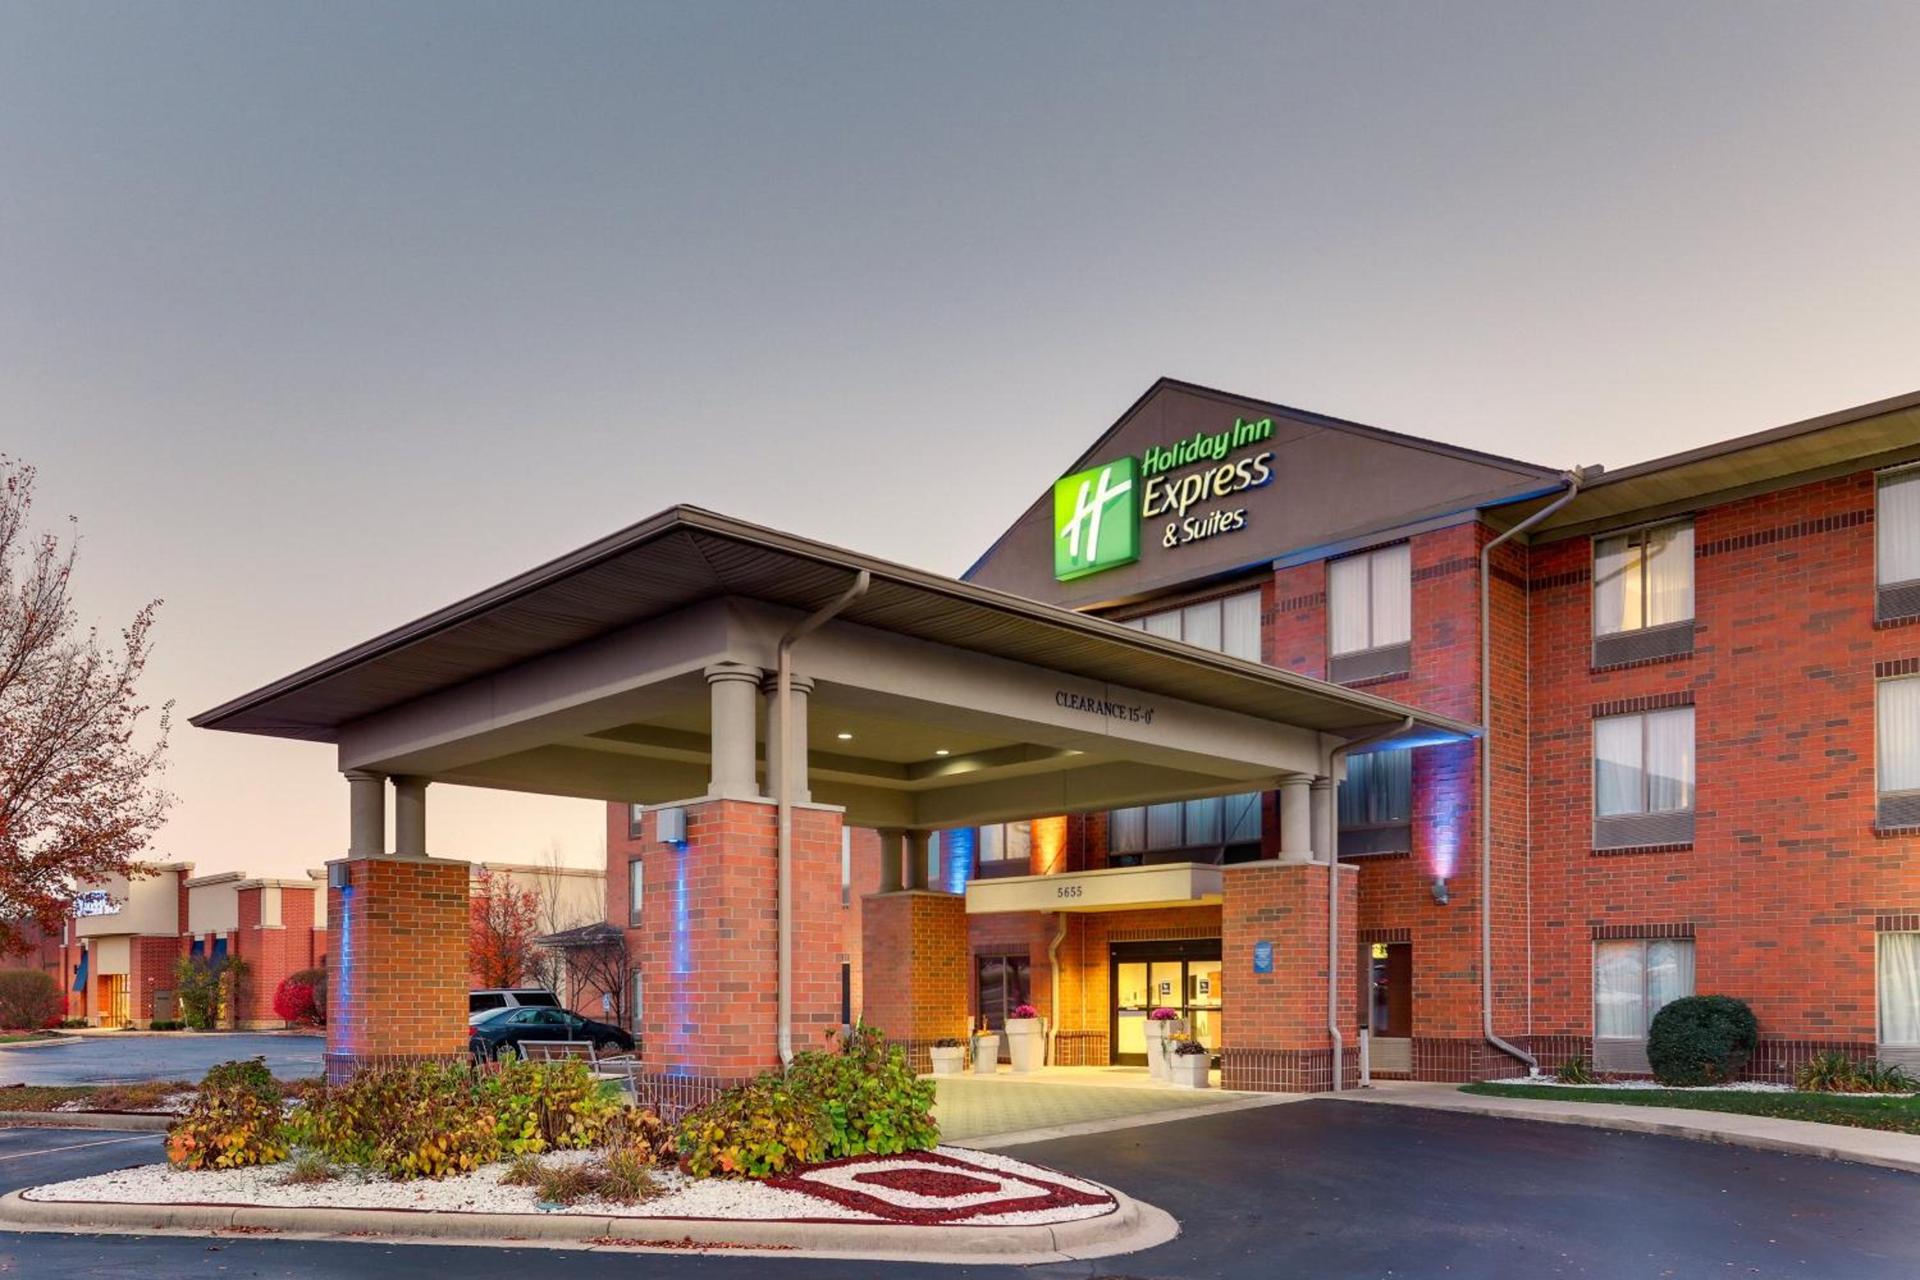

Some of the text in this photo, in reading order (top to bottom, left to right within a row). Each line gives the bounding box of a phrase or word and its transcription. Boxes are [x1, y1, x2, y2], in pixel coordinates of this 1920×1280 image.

[1142, 417, 1272, 476] Holiday Inn
[1142, 452, 1272, 517] Express
[1060, 466, 1132, 563] H
[1163, 509, 1245, 548] & Suites
[1055, 690, 1126, 720] CLEARANCE
[1057, 885, 1083, 898] 5655
